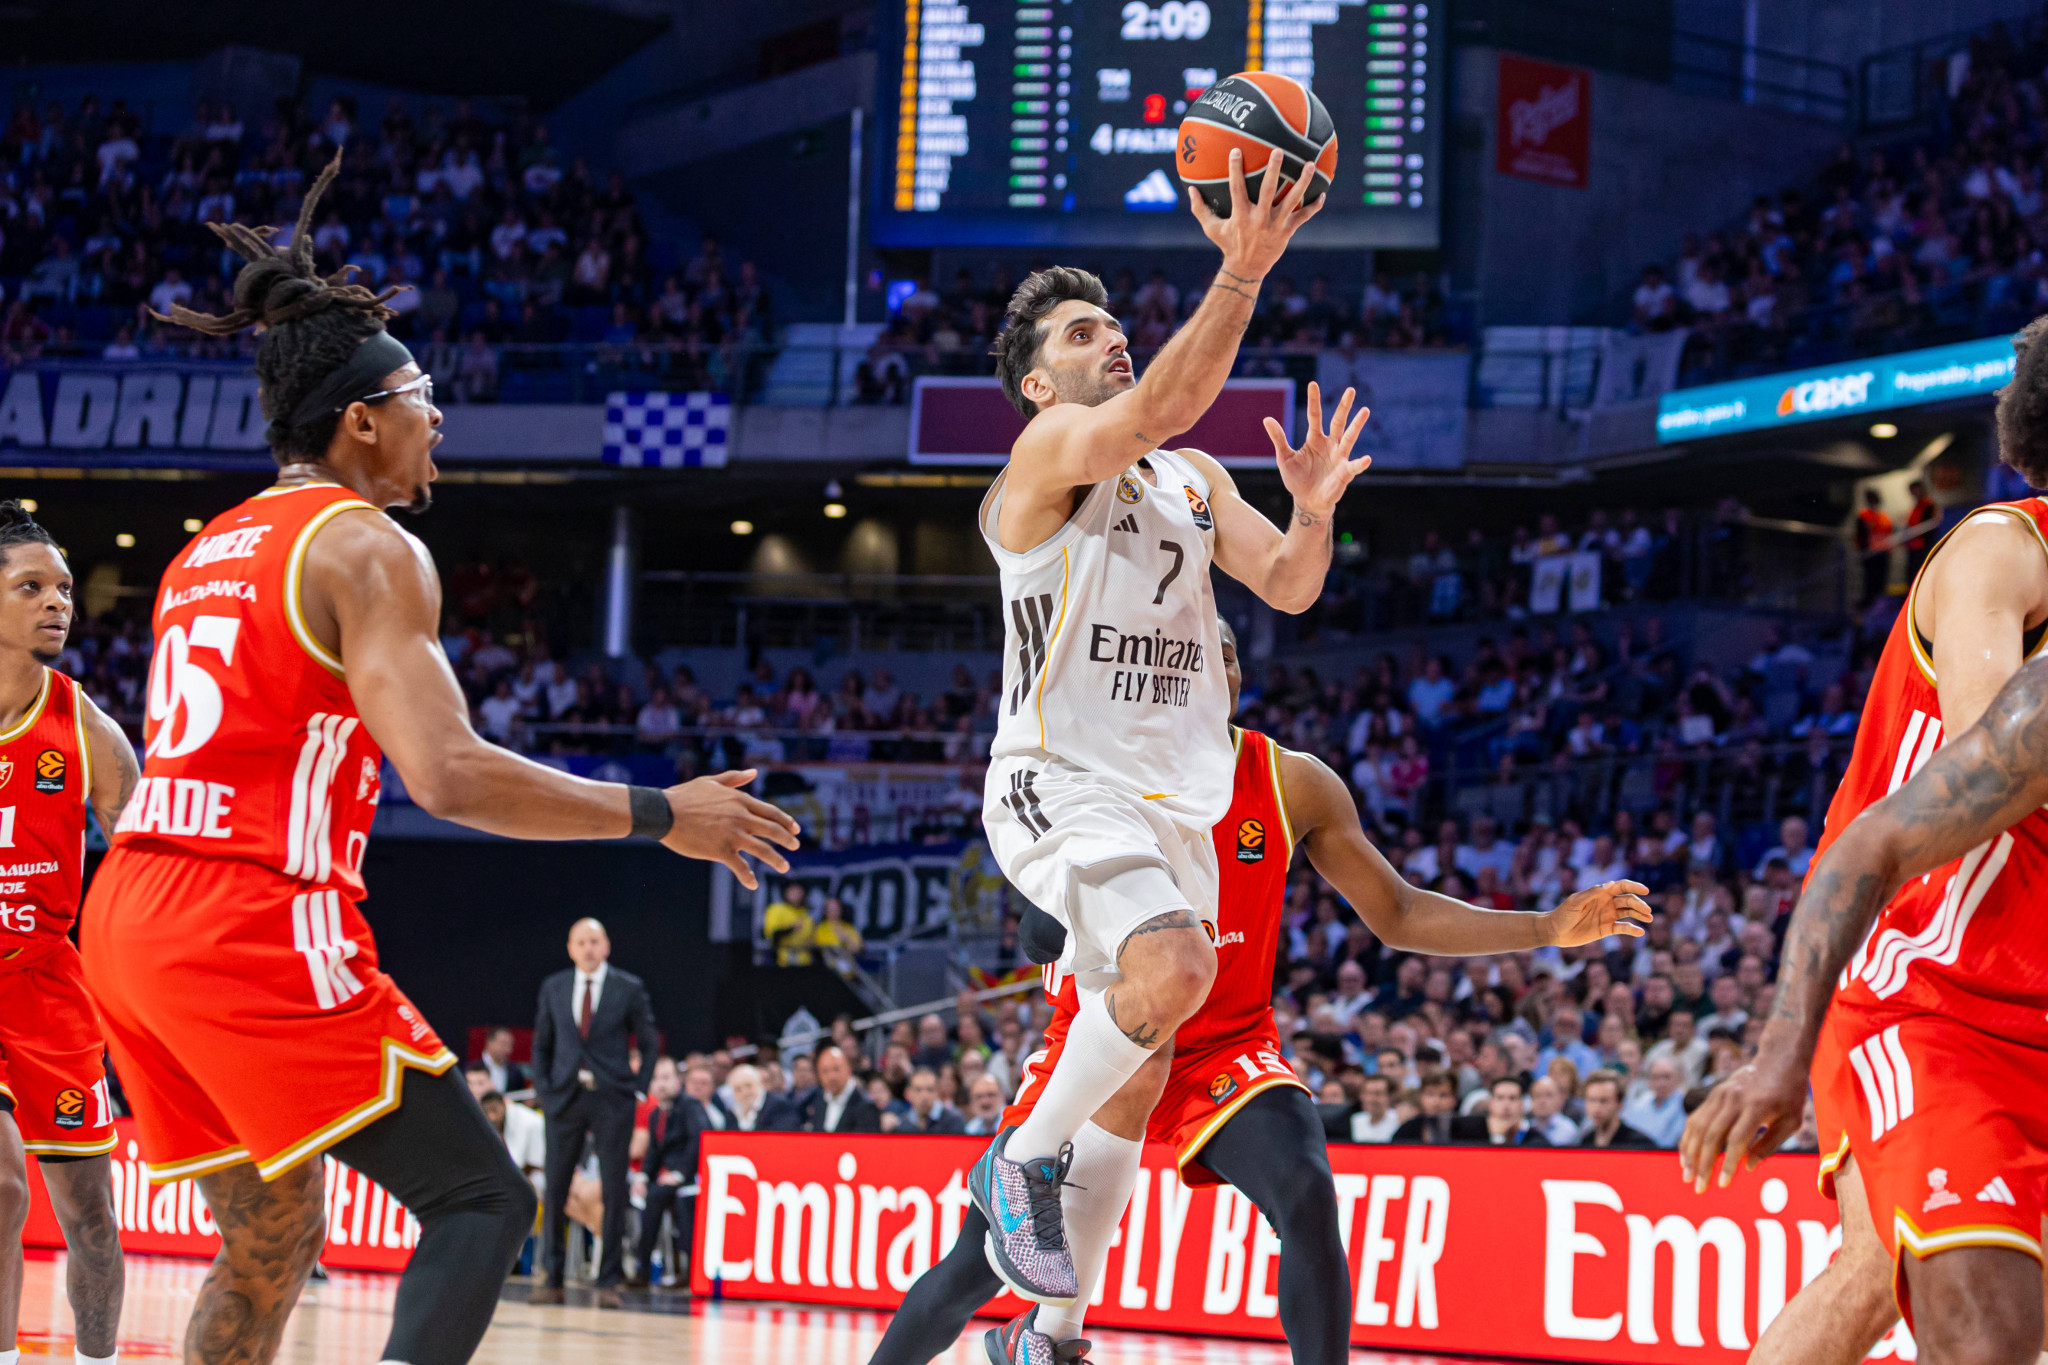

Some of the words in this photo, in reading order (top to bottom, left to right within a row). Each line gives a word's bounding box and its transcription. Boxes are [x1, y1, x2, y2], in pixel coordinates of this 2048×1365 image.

[1121, 1, 1211, 40] 2:09
[1200, 88, 1257, 129] LDING.
[1089, 123, 1113, 155] 4
[1152, 539, 1185, 605] 7
[1090, 623, 1204, 675] Emirates
[145, 614, 242, 760] 95
[1111, 670, 1148, 702] FLY
[1152, 674, 1191, 708] BETTER
[114, 776, 236, 838] RADE
[703, 1152, 970, 1293] Emirat
[1202, 1172, 1451, 1330] BETER
